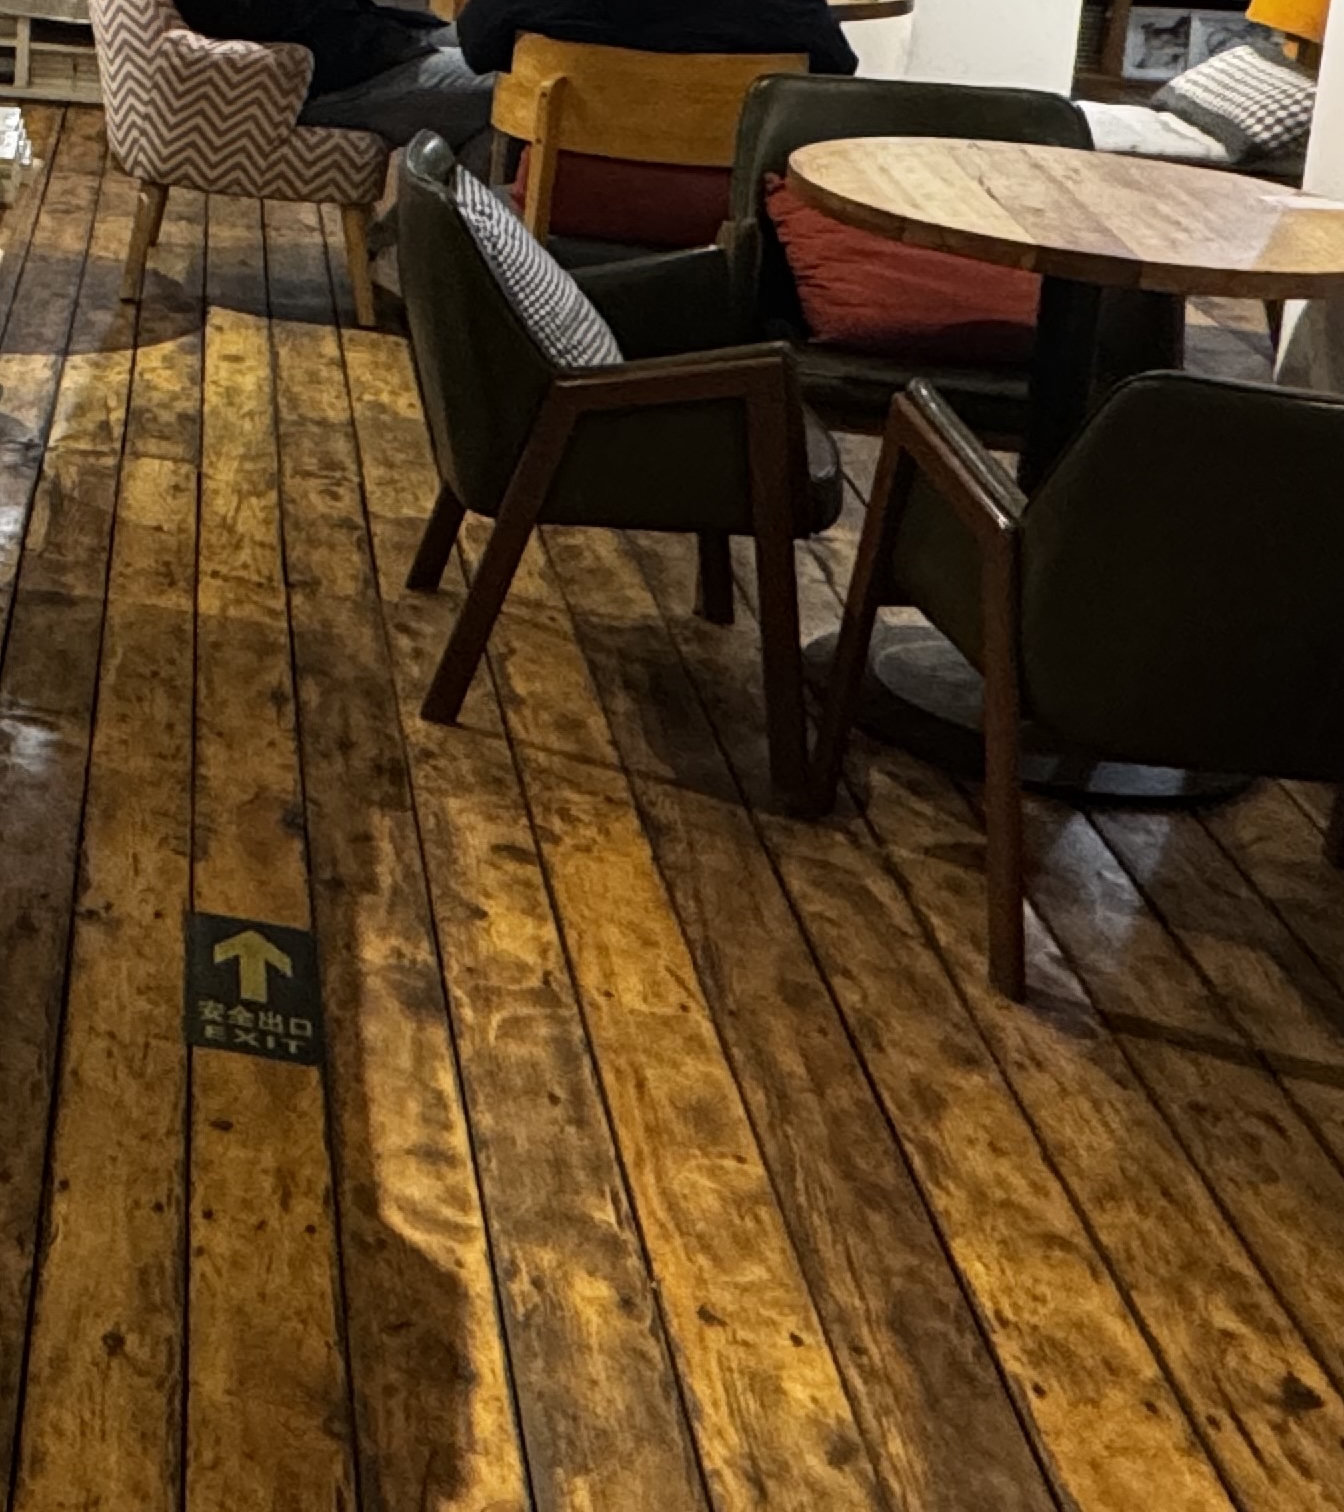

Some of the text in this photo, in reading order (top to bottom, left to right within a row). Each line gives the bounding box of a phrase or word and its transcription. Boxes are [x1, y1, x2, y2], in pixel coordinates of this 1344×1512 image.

[198, 999, 312, 1038] 安全出口
[204, 1024, 307, 1054] EXIT
